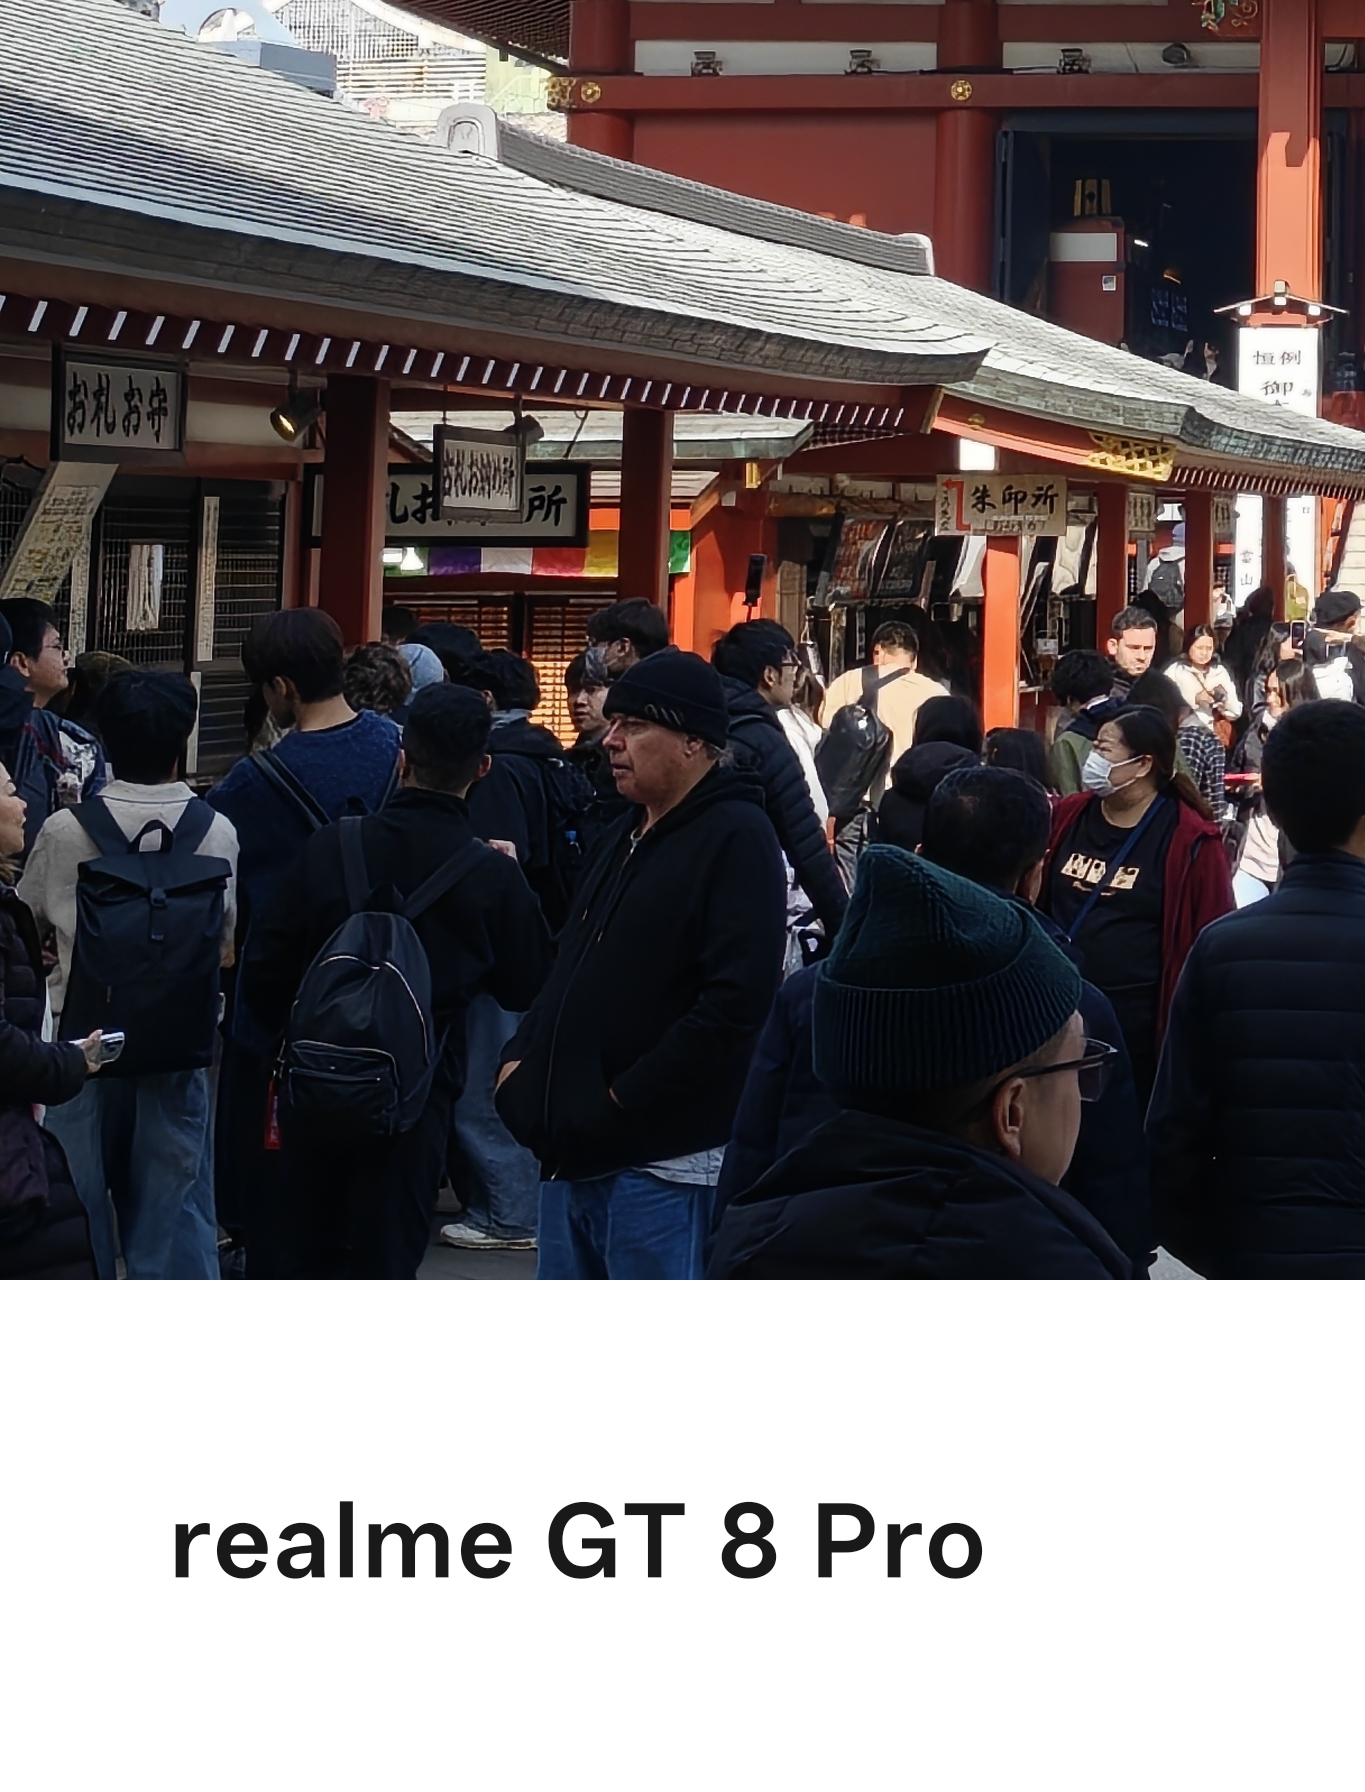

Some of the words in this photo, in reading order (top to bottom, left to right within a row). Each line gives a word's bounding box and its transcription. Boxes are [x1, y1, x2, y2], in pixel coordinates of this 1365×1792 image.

[1252, 350, 1301, 365] 恒例
[970, 483, 1059, 515] 朱印所
